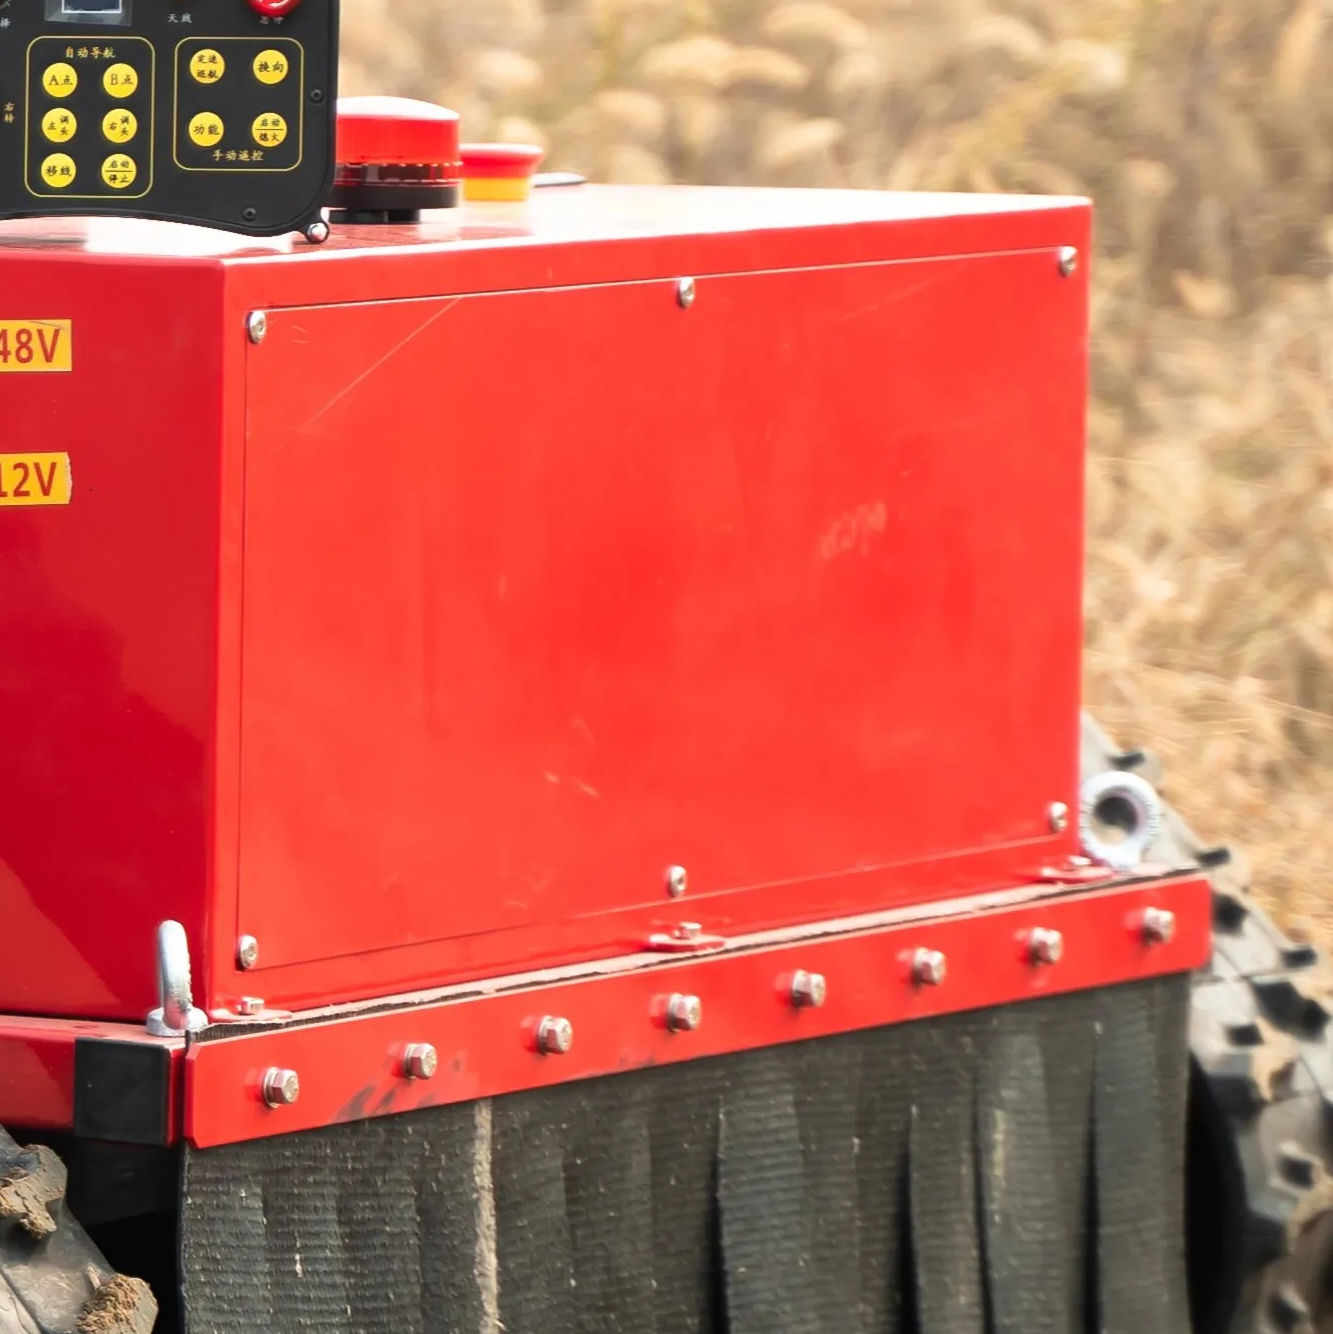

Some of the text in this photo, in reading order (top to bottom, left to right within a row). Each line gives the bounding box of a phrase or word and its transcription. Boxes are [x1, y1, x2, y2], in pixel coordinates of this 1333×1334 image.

[167, 13, 193, 23] 天线
[65, 46, 116, 59] 自动导航
[257, 60, 284, 73] 换向
[260, 118, 280, 127] 启动
[193, 124, 220, 135] 功能
[212, 149, 264, 161] 手动遥控
[109, 174, 130, 183] 停止
